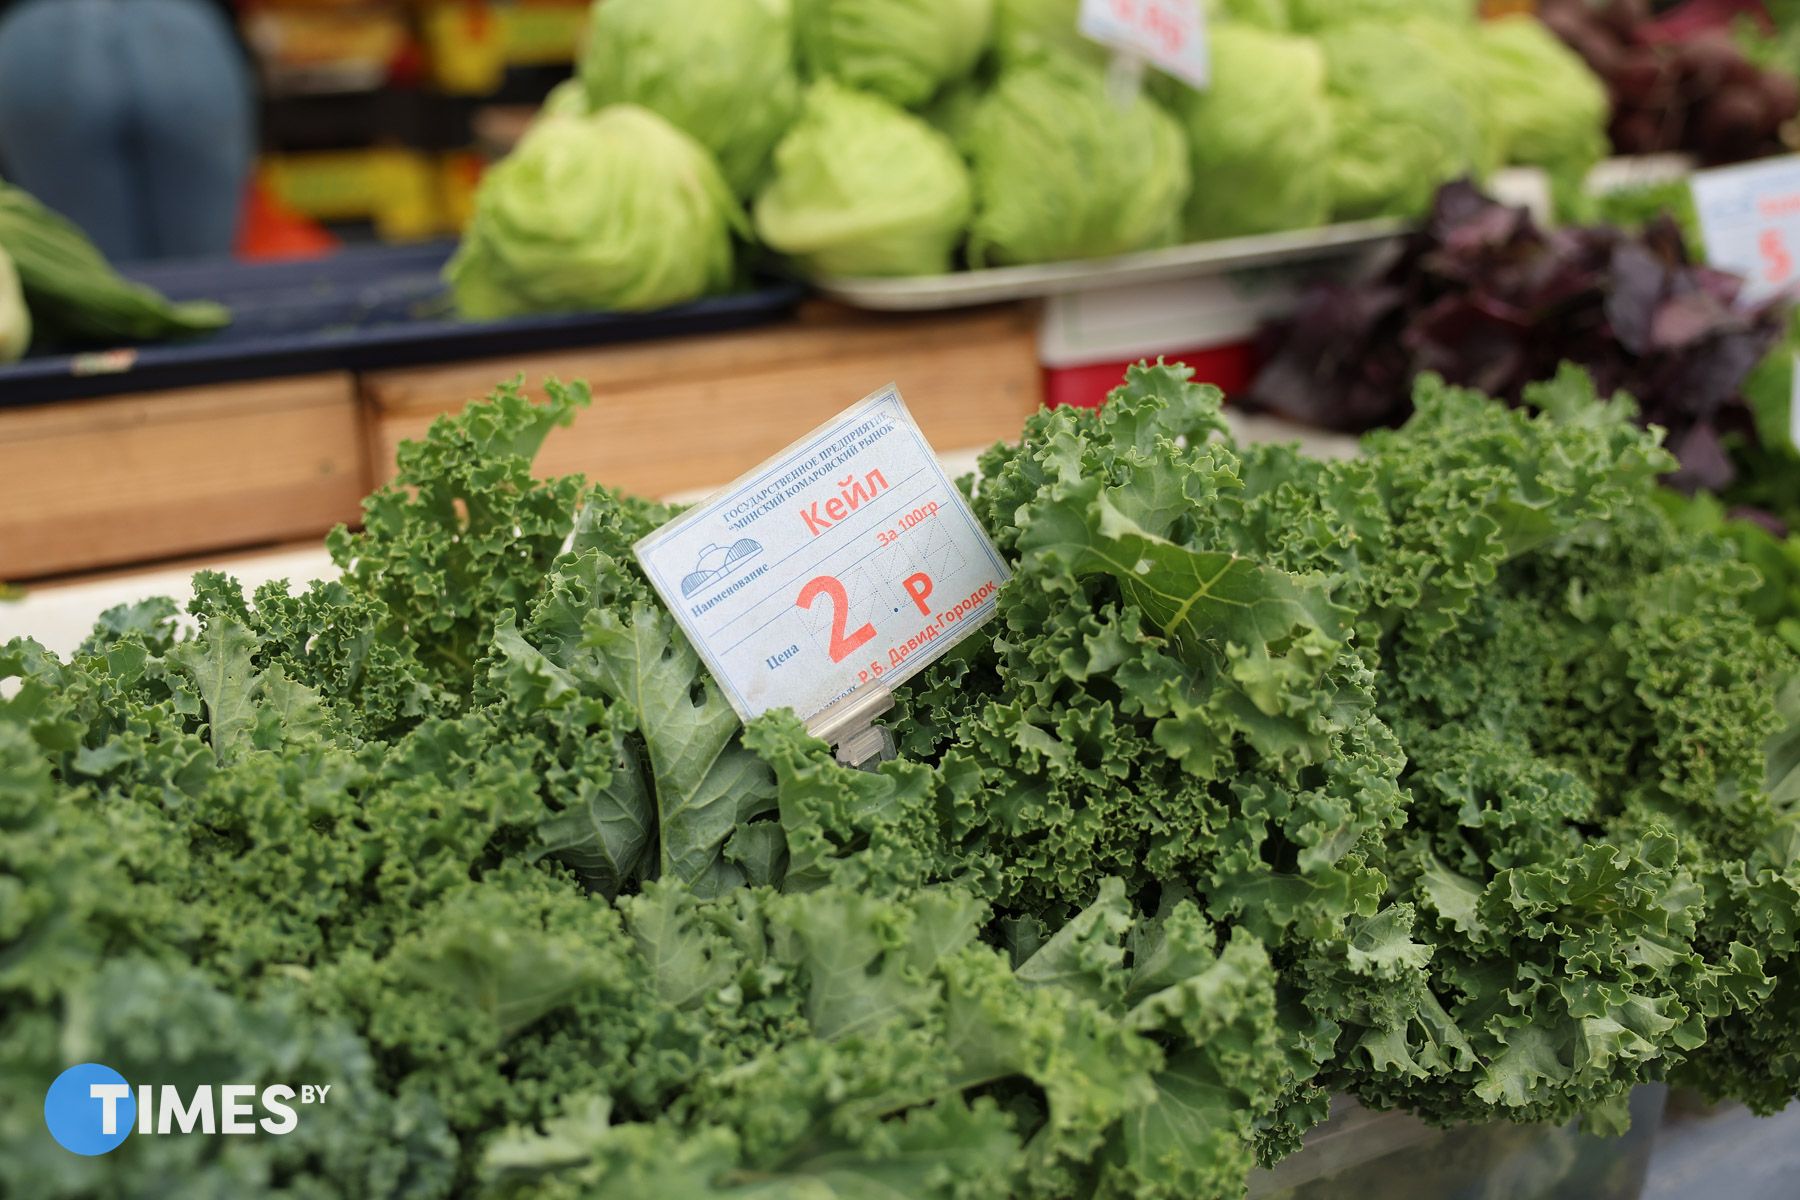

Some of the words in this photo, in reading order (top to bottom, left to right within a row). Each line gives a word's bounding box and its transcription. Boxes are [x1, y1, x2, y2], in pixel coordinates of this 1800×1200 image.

[723, 456, 820, 523] ГОСУДАРСТВЕННОЕ
[819, 411, 889, 461] ПРЕДПРИЯТИЕ
[784, 446, 860, 499] КОМАРОВСКИЙ
[799, 468, 890, 537] Кейл
[876, 529, 899, 548] За
[898, 499, 940, 533] 100гр
[691, 562, 770, 618] Наименование
[766, 643, 801, 671] Цена
[795, 575, 877, 664] 2
[902, 571, 934, 617] Р
[887, 580, 998, 668] Давид-Городок
